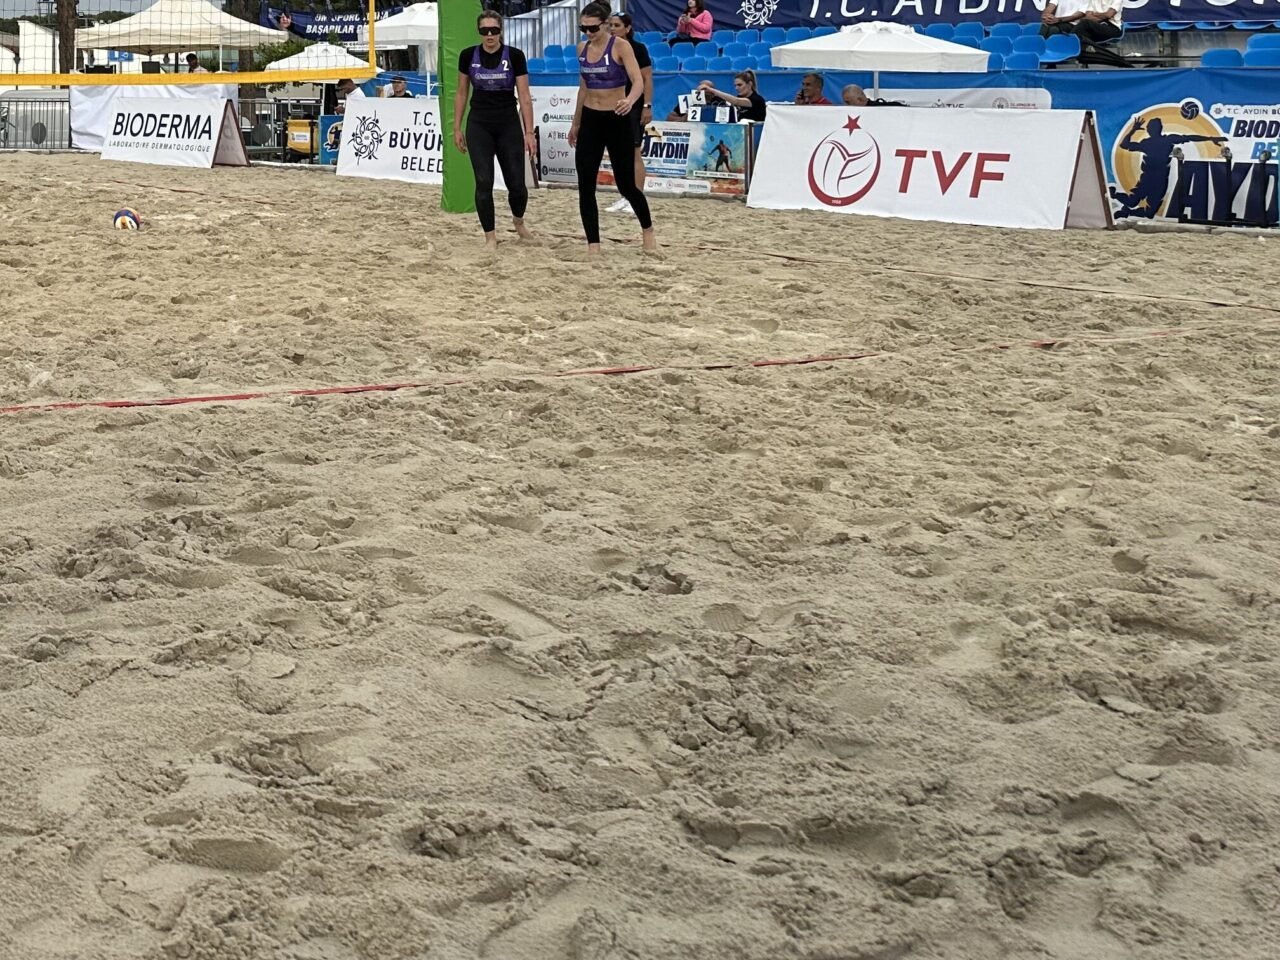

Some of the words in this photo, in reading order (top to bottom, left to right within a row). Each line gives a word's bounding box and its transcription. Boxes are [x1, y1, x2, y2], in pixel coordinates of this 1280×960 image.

[502, 60, 509, 71] 2
[604, 54, 610, 65] 1
[683, 96, 689, 111] 1
[413, 111, 437, 127] T.C.
[691, 110, 698, 119] 2
[112, 112, 212, 141] BIODERMA
[109, 140, 149, 149] LABORATOIRE
[151, 142, 211, 153] DERMATOLOGIQUE
[650, 142, 689, 159] AYDIN
[894, 148, 1011, 199] TVF
